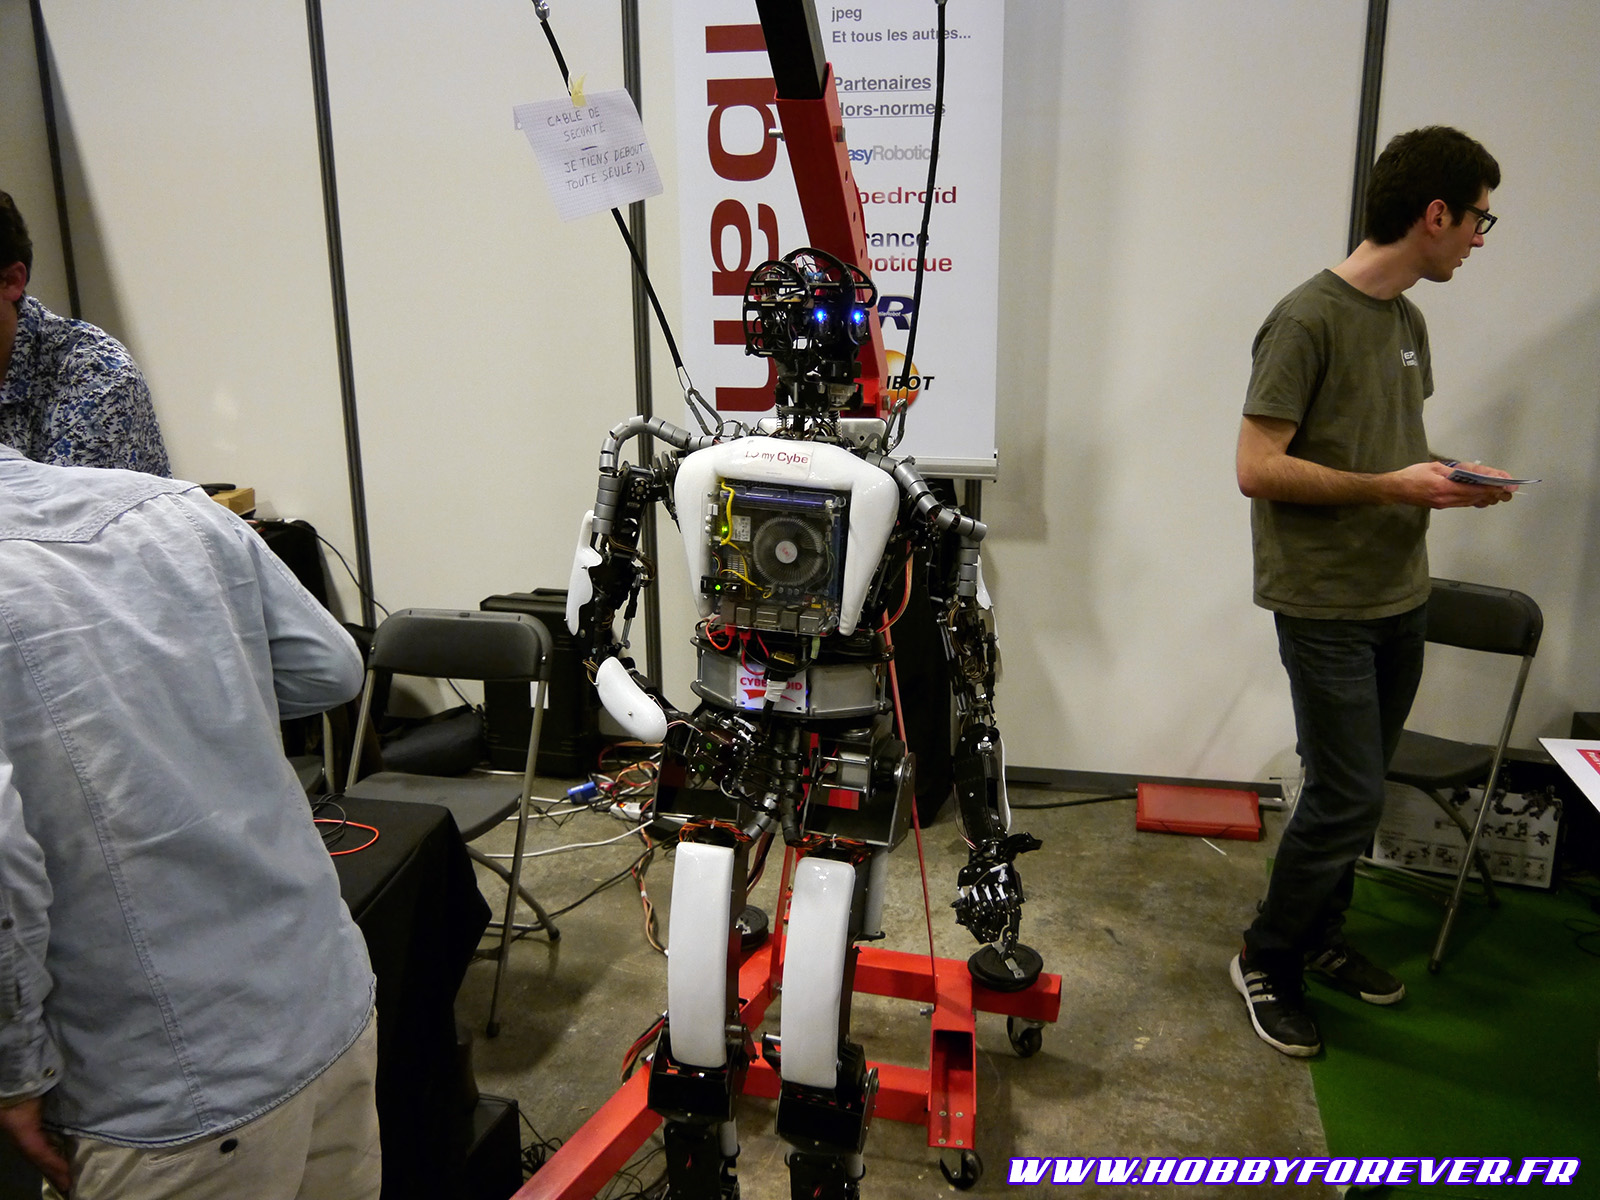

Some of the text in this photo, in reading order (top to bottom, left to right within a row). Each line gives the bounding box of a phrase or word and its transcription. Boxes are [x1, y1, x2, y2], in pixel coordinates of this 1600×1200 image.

[831, 7, 863, 22] jpeg
[832, 30, 847, 43] Et
[851, 29, 883, 43] tous
[887, 28, 908, 41] les
[834, 75, 932, 91] Partenaires
[547, 106, 601, 127] CABLE DE
[564, 143, 645, 173] JE TIENS DEBOUT
[847, 144, 940, 165] asyRobotic
[565, 173, 598, 191] TOUTE
[602, 161, 632, 182] SEULE
[761, 452, 775, 462] my
[740, 676, 803, 691] CYBEID
